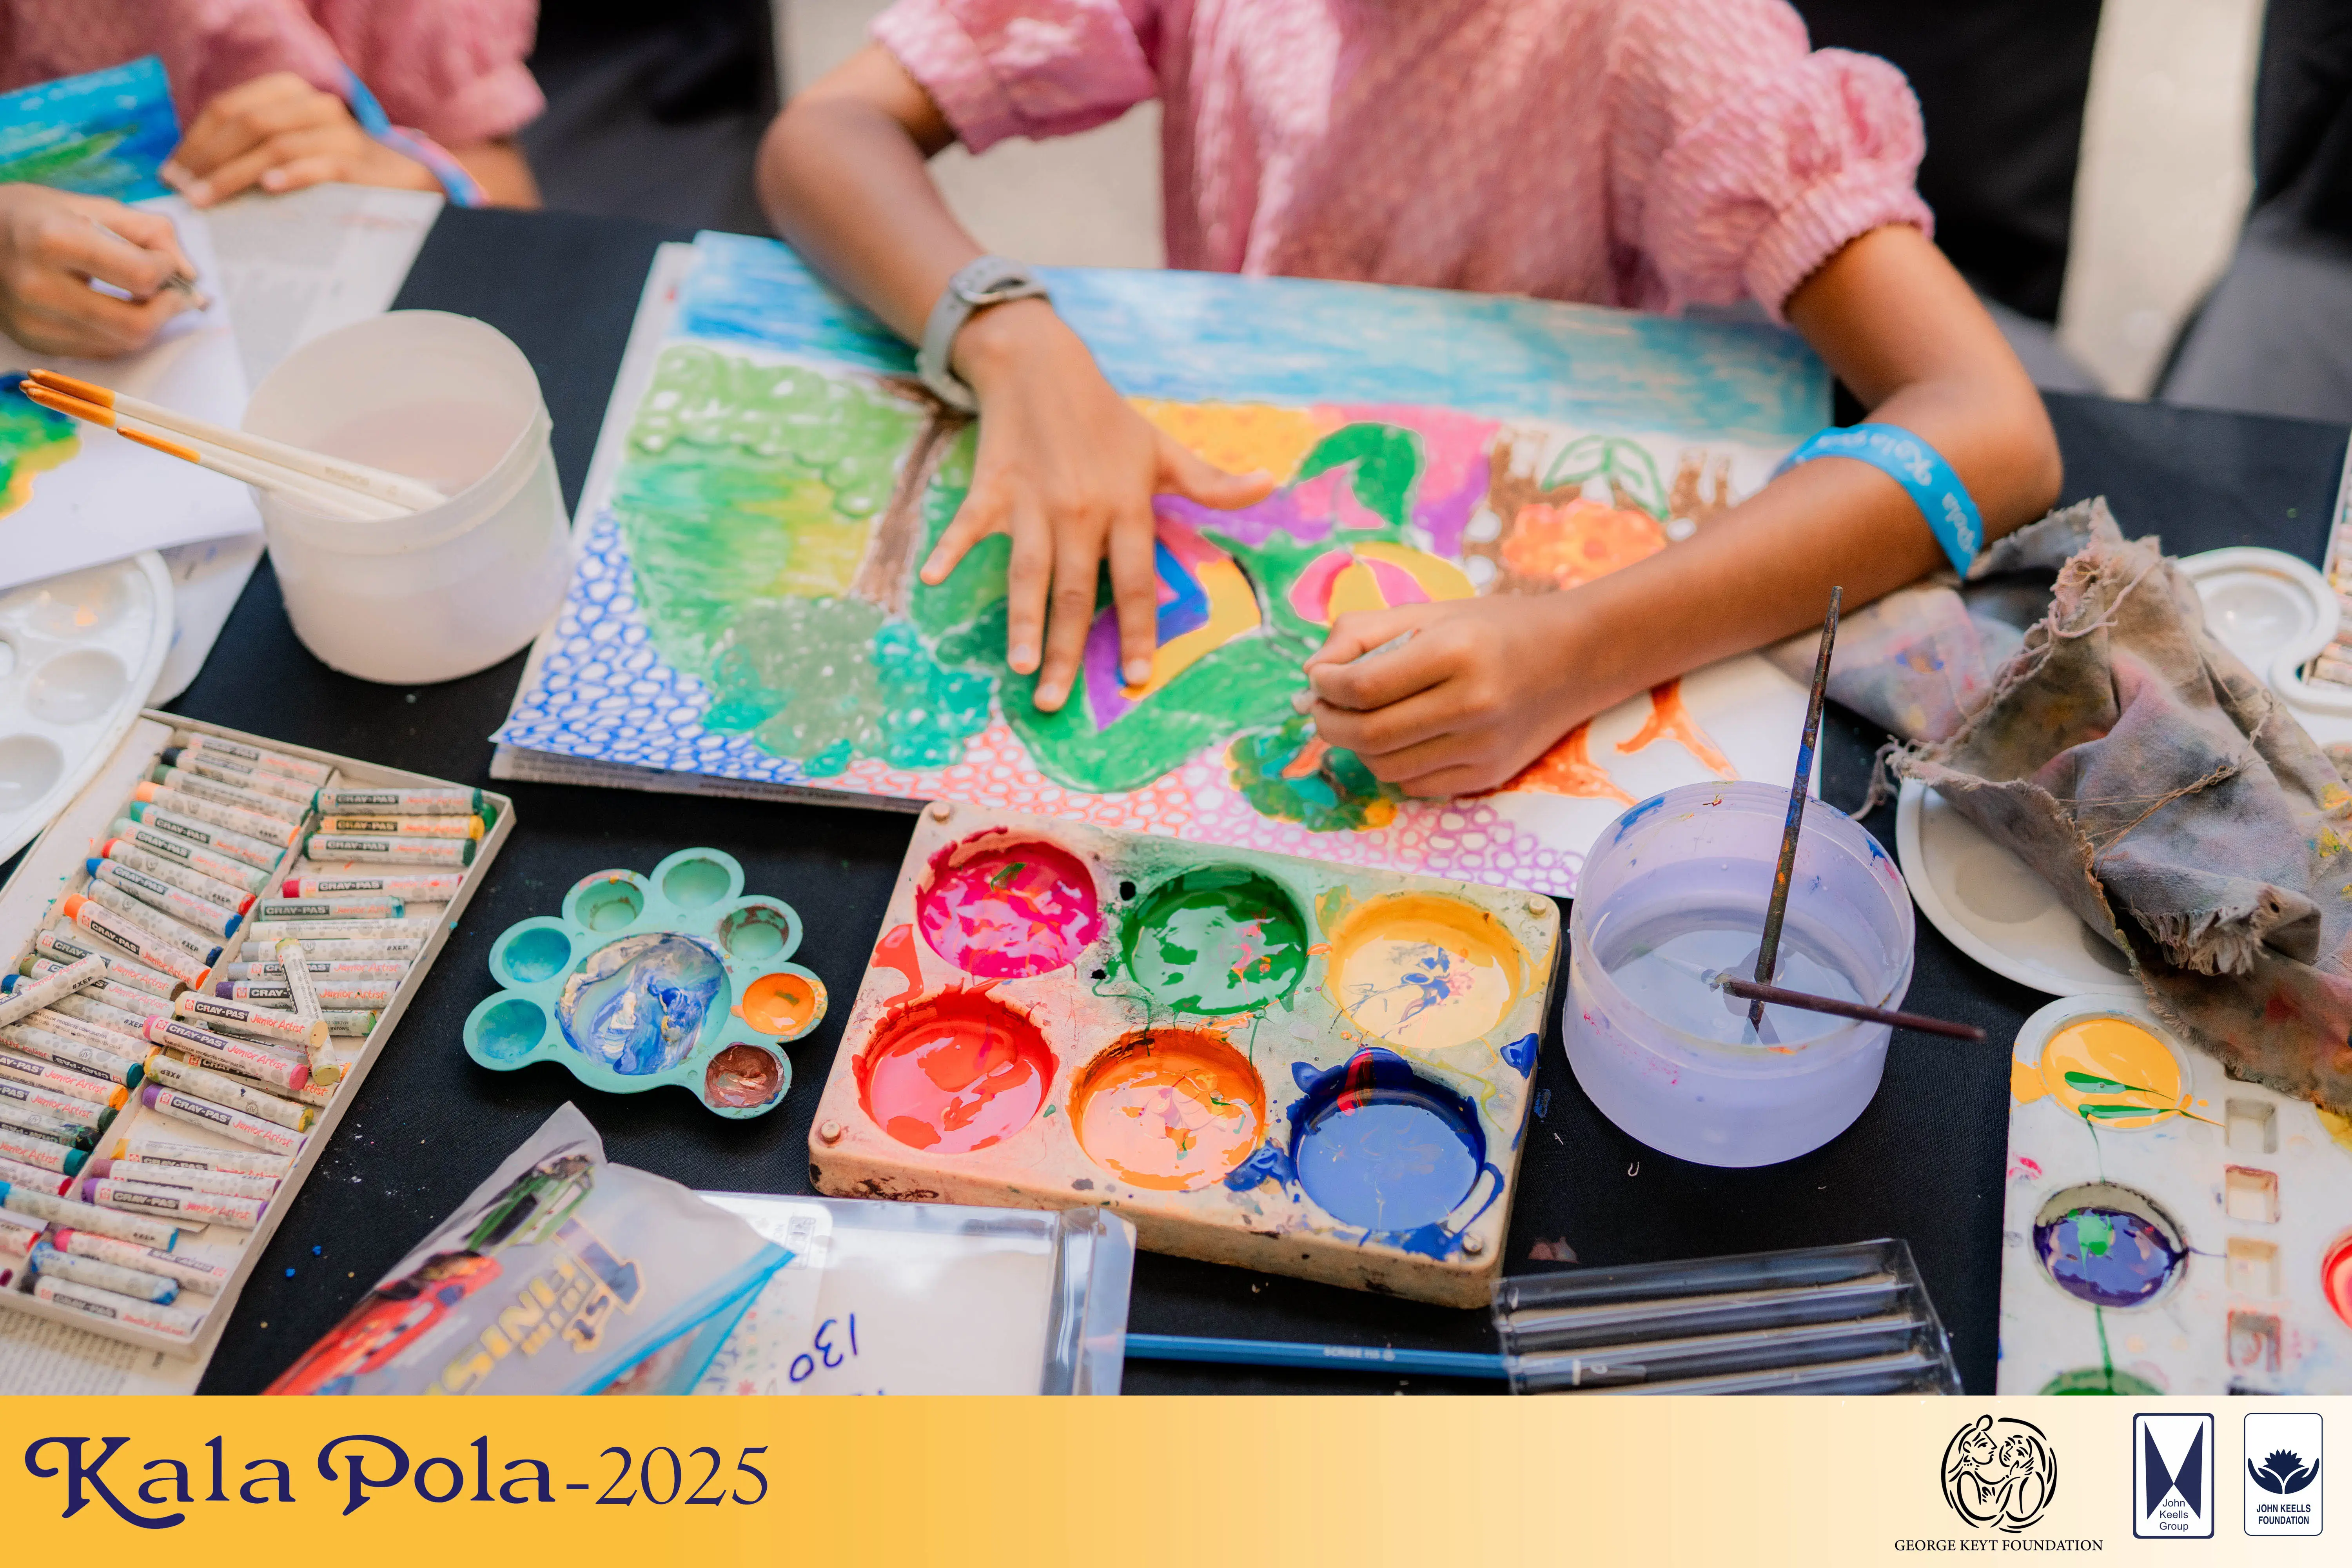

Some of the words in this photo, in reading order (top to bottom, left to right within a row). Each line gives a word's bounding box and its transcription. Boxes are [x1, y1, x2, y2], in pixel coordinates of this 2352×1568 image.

[92, 924, 137, 953] CRAY-PAS
[197, 1003, 245, 1019] CRAY-PAS
[169, 1025, 223, 1048] CRAY-PAS
[227, 1044, 258, 1059] Junior
[45, 1070, 77, 1085] Junior
[76, 1079, 107, 1093] Artist
[304, 1083, 328, 1096] rtist
[31, 1094, 63, 1112] Junior
[173, 1099, 228, 1123] CRAY-PAS
[233, 1120, 264, 1136] Junior
[263, 1130, 294, 1147] Artist
